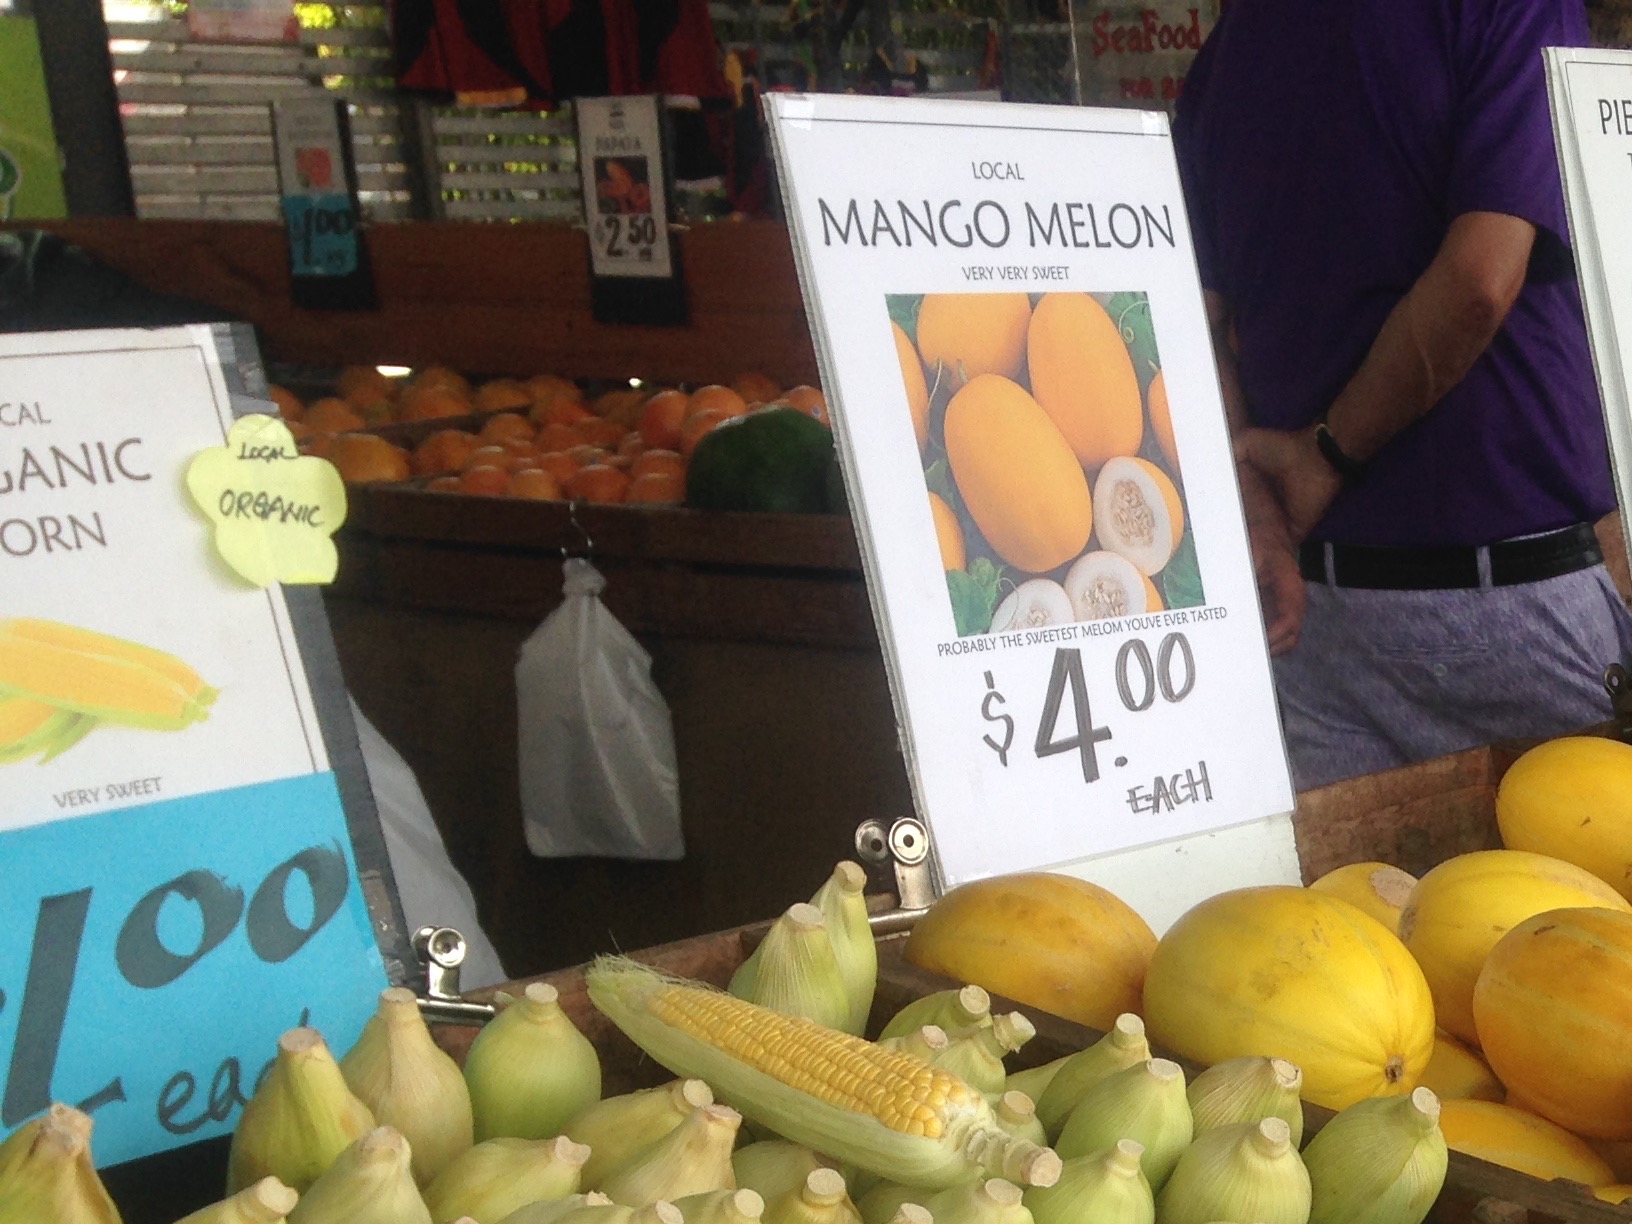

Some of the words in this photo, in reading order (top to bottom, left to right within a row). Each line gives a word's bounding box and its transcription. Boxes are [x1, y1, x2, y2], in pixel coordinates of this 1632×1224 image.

[972, 161, 1025, 181] LOCAL
[818, 197, 1010, 248] MANGO
[1024, 201, 1175, 249] MELON
[962, 266, 995, 281] VERY
[997, 266, 1029, 281] VERY
[1032, 266, 1070, 280] SWEET
[236, 441, 300, 464] LOCAL
[219, 488, 326, 528] ORGANIC
[936, 636, 997, 657] PROBABLY
[1000, 633, 1024, 648] THE
[1026, 626, 1078, 645] SWEETEST
[1163, 611, 1189, 627] EVER
[1190, 607, 1228, 622] TASTED
[53, 787, 100, 809] VERY
[105, 776, 164, 800] SWEET
[1126, 760, 1214, 815] EACH
